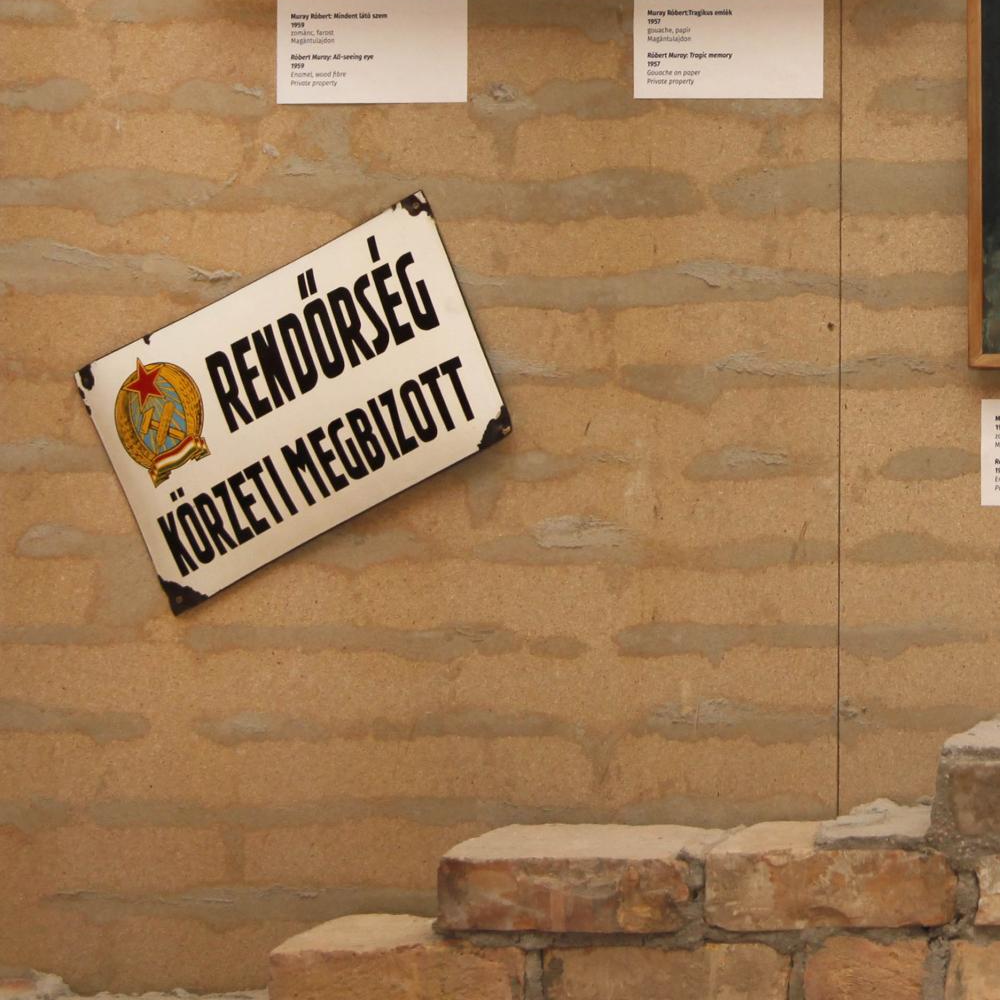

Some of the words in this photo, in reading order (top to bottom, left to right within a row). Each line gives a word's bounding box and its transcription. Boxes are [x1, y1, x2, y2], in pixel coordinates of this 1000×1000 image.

[205, 235, 440, 433] RENDŐRSÉG
[157, 456, 299, 577] KÖRZETI
[281, 356, 475, 506] MEGBIZOTT
